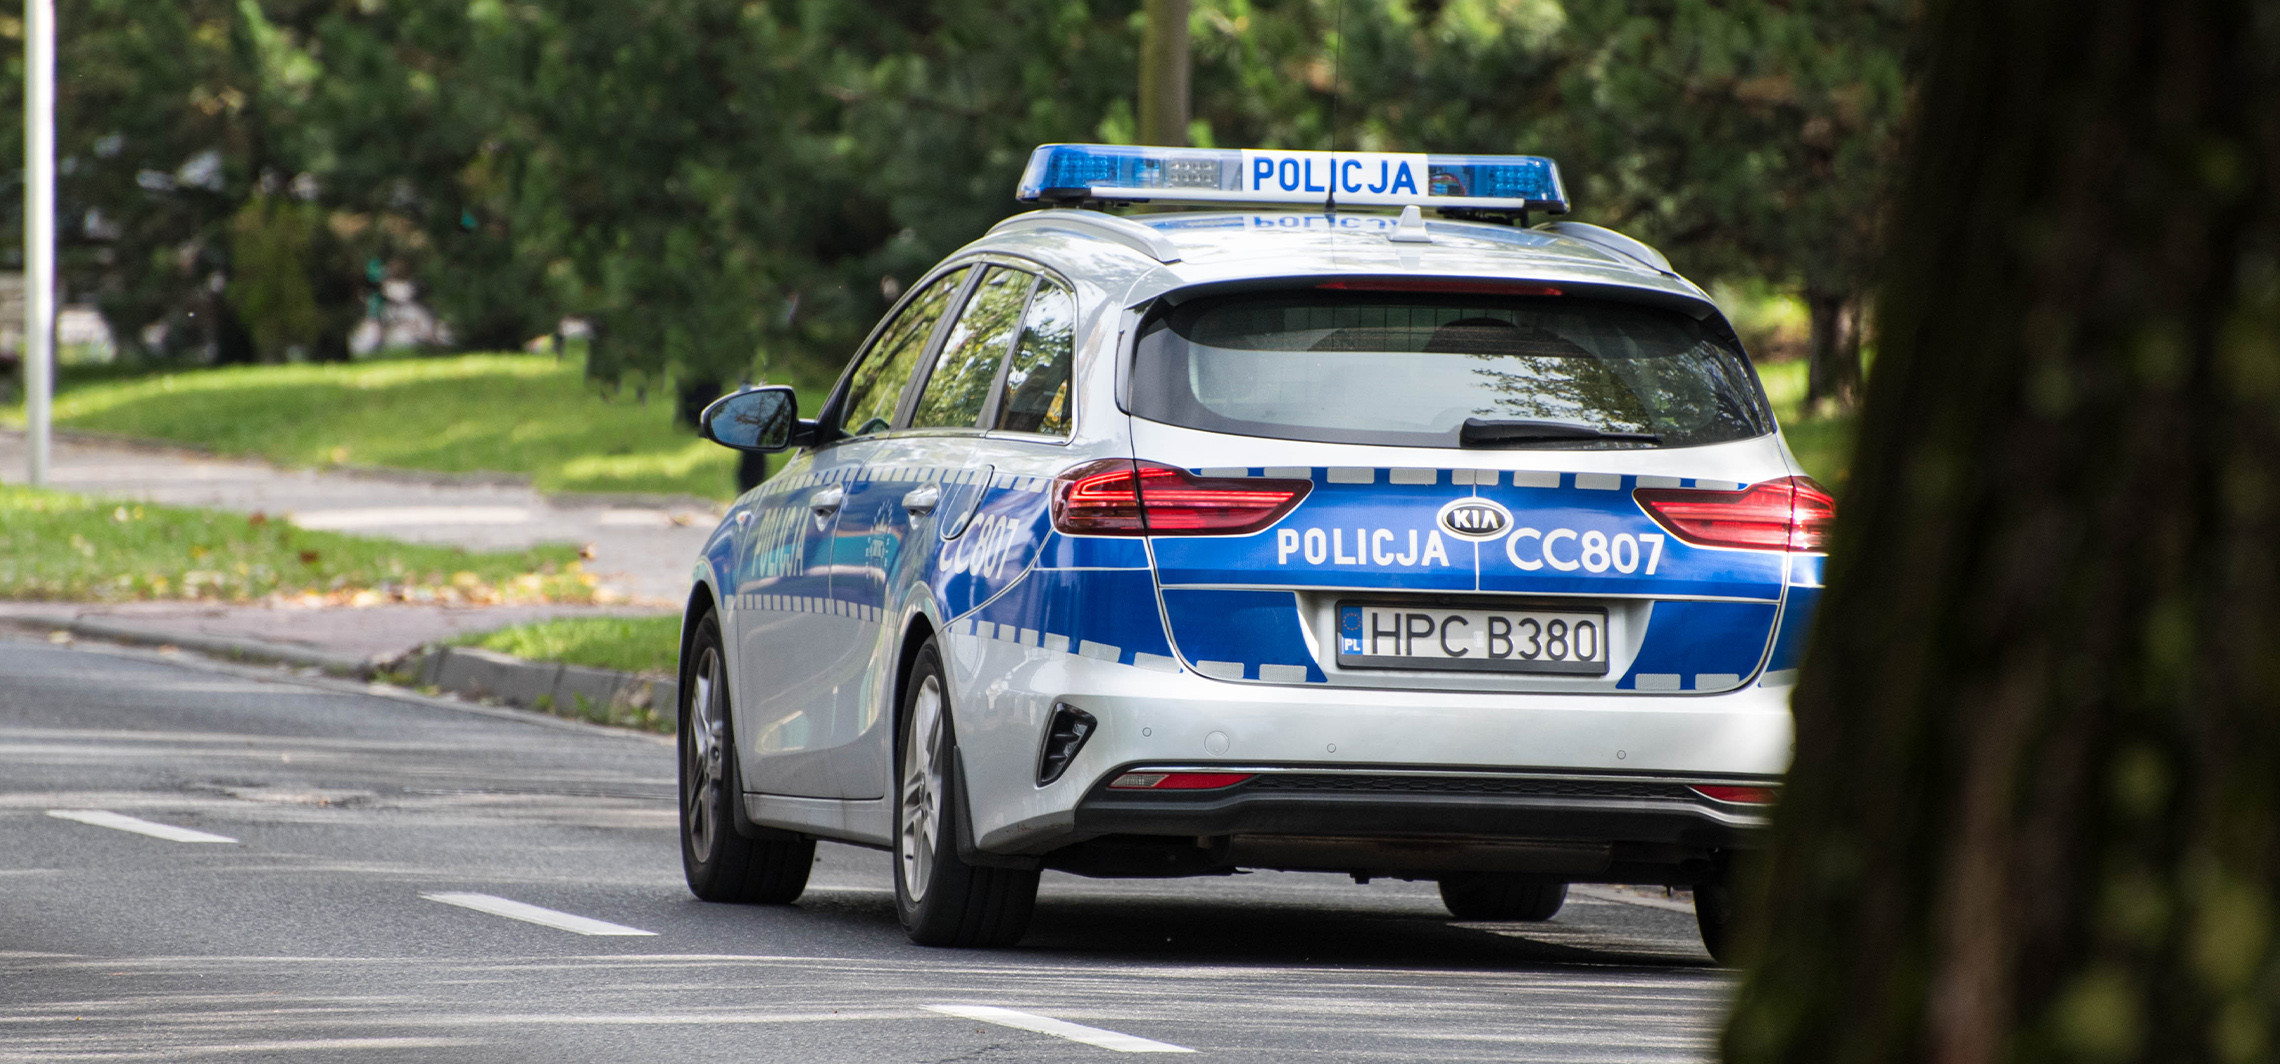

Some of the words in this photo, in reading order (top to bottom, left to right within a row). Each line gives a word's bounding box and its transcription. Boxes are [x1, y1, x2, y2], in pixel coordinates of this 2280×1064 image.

[1253, 156, 1418, 195] POLICJA
[752, 506, 811, 577] POLICJA
[1453, 510, 1499, 529] KIA
[939, 511, 1020, 579] CC807
[1277, 528, 1450, 567] POLICJA
[1506, 528, 1664, 575] CC807
[1344, 638, 1361, 651] PL
[1372, 612, 1469, 657] HPC
[1488, 616, 1598, 662] B380
